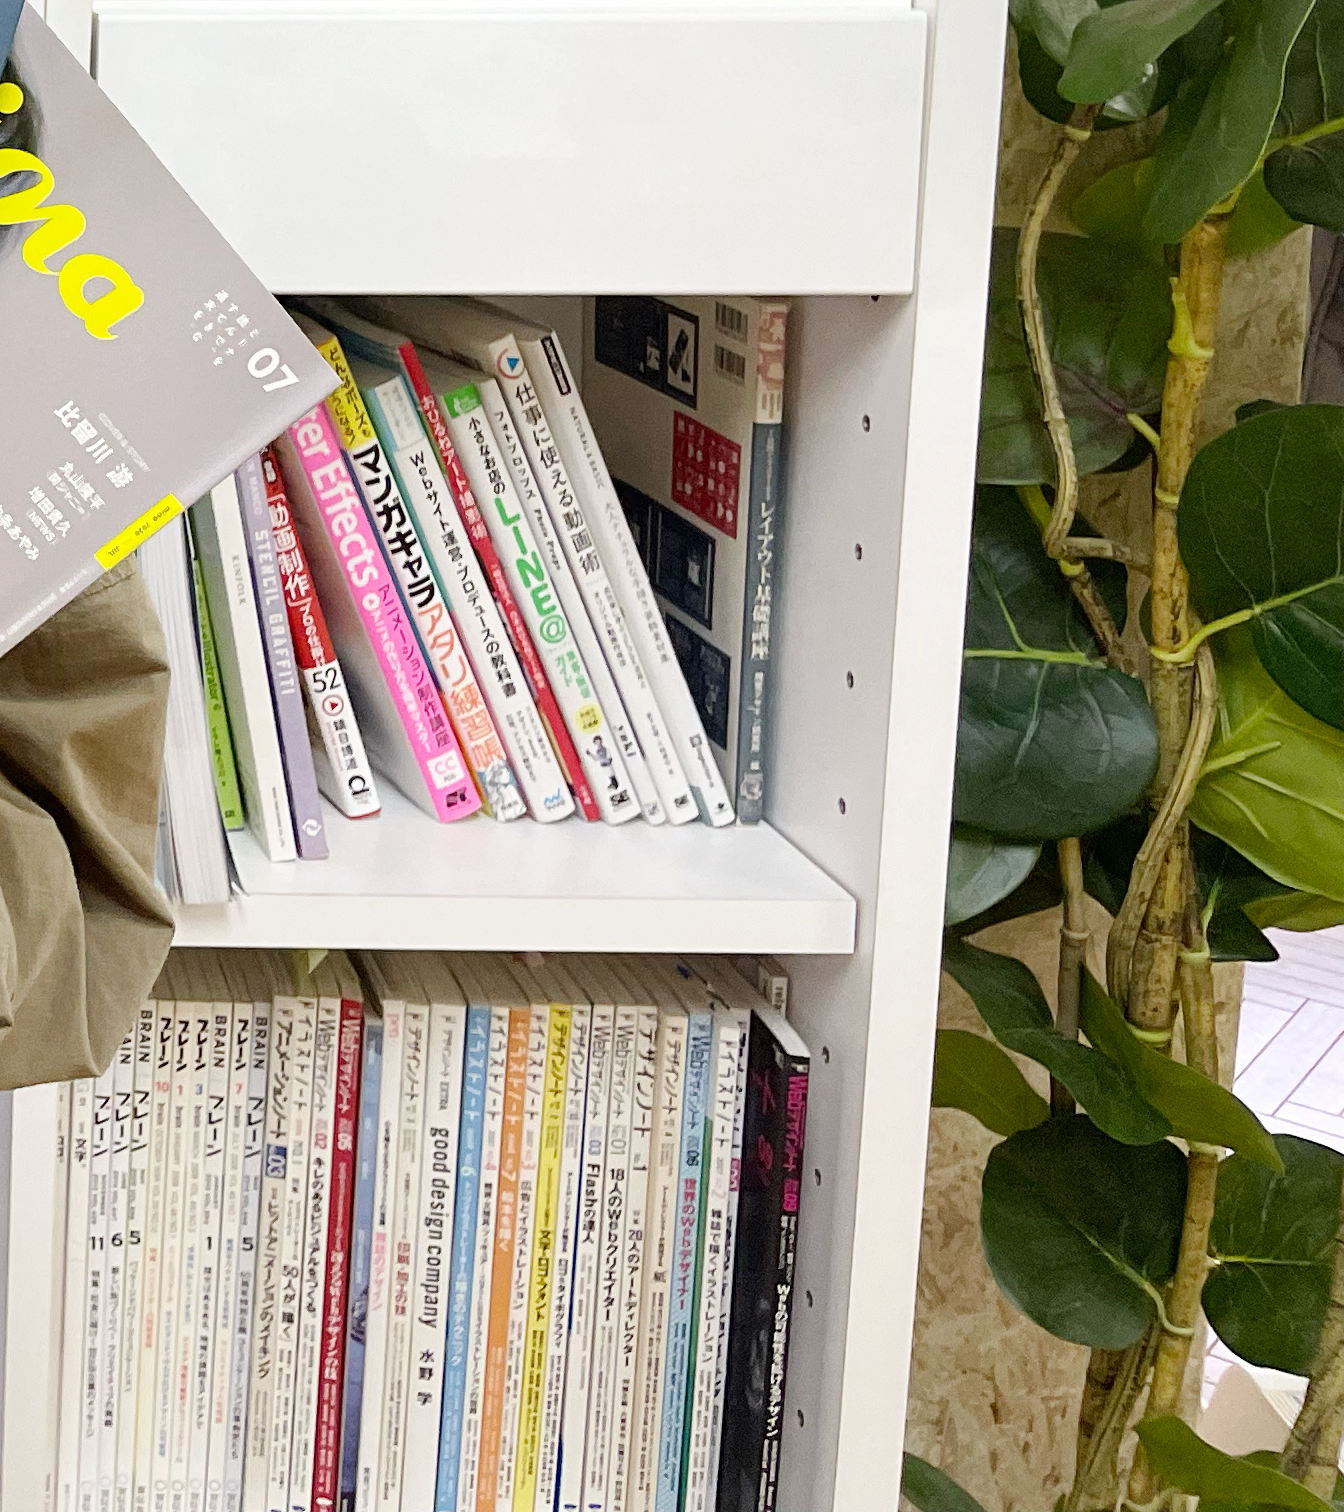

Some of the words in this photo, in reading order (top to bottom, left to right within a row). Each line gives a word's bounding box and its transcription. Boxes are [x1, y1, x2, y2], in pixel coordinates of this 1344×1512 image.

[247, 347, 300, 393] 07
[53, 399, 114, 465] 比留川
[514, 381, 601, 577] 仕事に使える動画術
[311, 457, 379, 589] Effects
[468, 416, 506, 496] 小さなお店の
[494, 497, 567, 644] LINE@
[232, 553, 247, 607] KINFOLK
[253, 529, 280, 607] STENCIL
[268, 611, 296, 696] GRAFFITI
[311, 667, 342, 695] 52
[137, 1009, 154, 1064] BRAIN
[157, 1016, 173, 1070] ブレーン
[175, 1019, 191, 1074] ブレーン
[194, 1018, 210, 1073] ブレーン
[212, 1014, 228, 1069] BRAIN
[234, 1018, 250, 1072] ブレーン
[251, 1016, 268, 1070] BRAIN
[291, 1015, 313, 1112] イラストノート
[633, 1027, 659, 1139] デザインノート
[661, 1038, 683, 1116] デザインノート
[714, 1042, 737, 1148] イラストノート
[204, 1094, 225, 1158] ブレーン
[243, 1095, 265, 1160] ブレーン
[428, 1126, 451, 1174] good
[424, 1177, 448, 1240] design
[89, 1236, 105, 1252] 11
[111, 1233, 124, 1249] 6
[129, 1230, 142, 1246] 5
[204, 1235, 214, 1251] 1
[241, 1236, 255, 1252] 5
[416, 1241, 443, 1330] company
